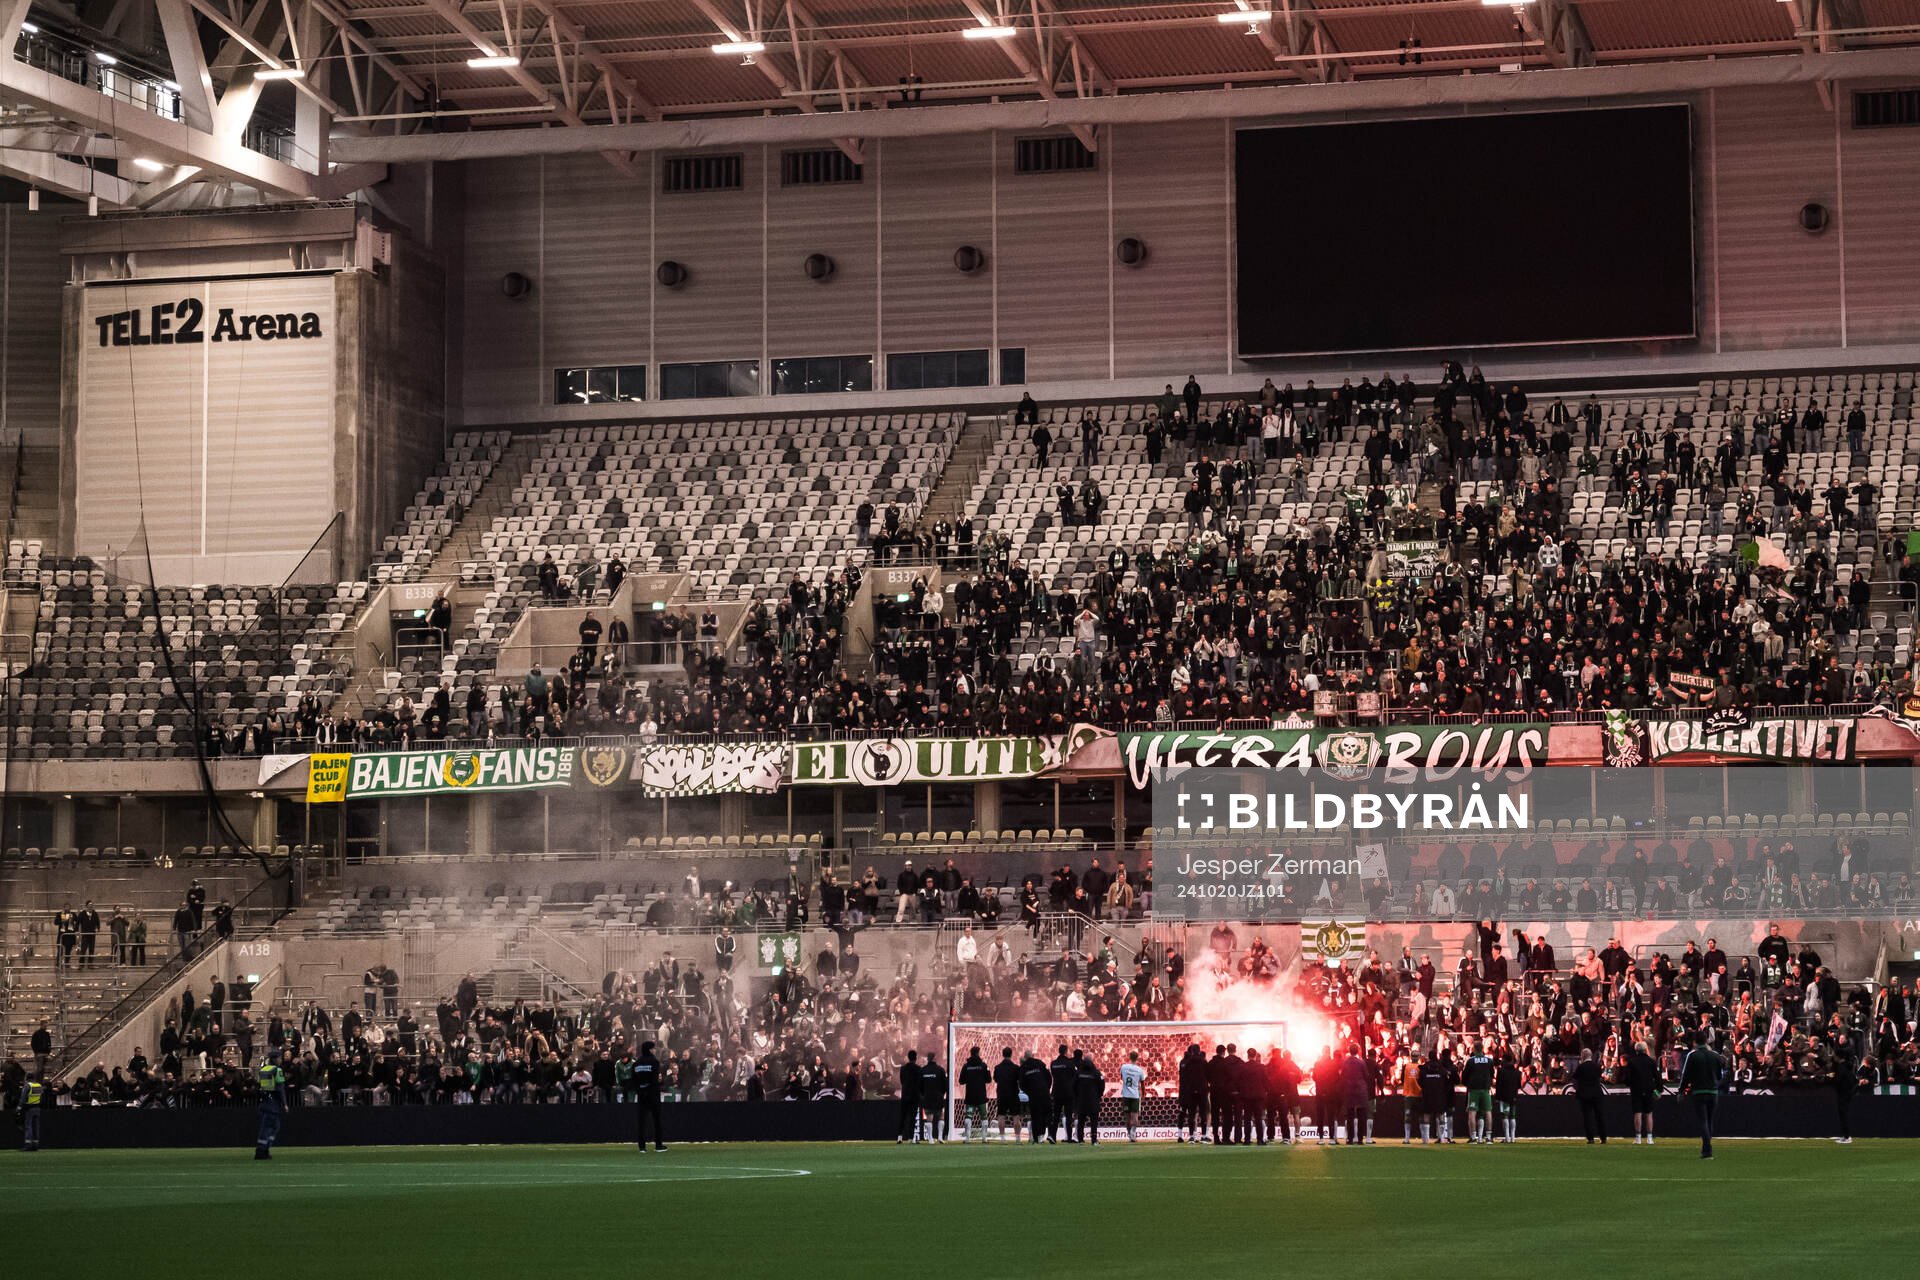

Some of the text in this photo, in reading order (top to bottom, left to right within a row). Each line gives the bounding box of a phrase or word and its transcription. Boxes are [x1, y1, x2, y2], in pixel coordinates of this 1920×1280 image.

[95, 297, 322, 347] TELE2 Arena
[888, 571, 918, 582] B337
[406, 587, 434, 599] B338
[1706, 708, 1748, 725] DEFEND
[1272, 719, 1315, 731] JUNIORS
[313, 759, 348, 770] BAJEN
[1125, 727, 1543, 790] ULTRA BOYS
[351, 754, 449, 791] BAJEN
[476, 747, 559, 785] FANS
[313, 771, 340, 782] CLUB
[239, 944, 270, 956] A138
[1125, 1076, 1133, 1087] 8
